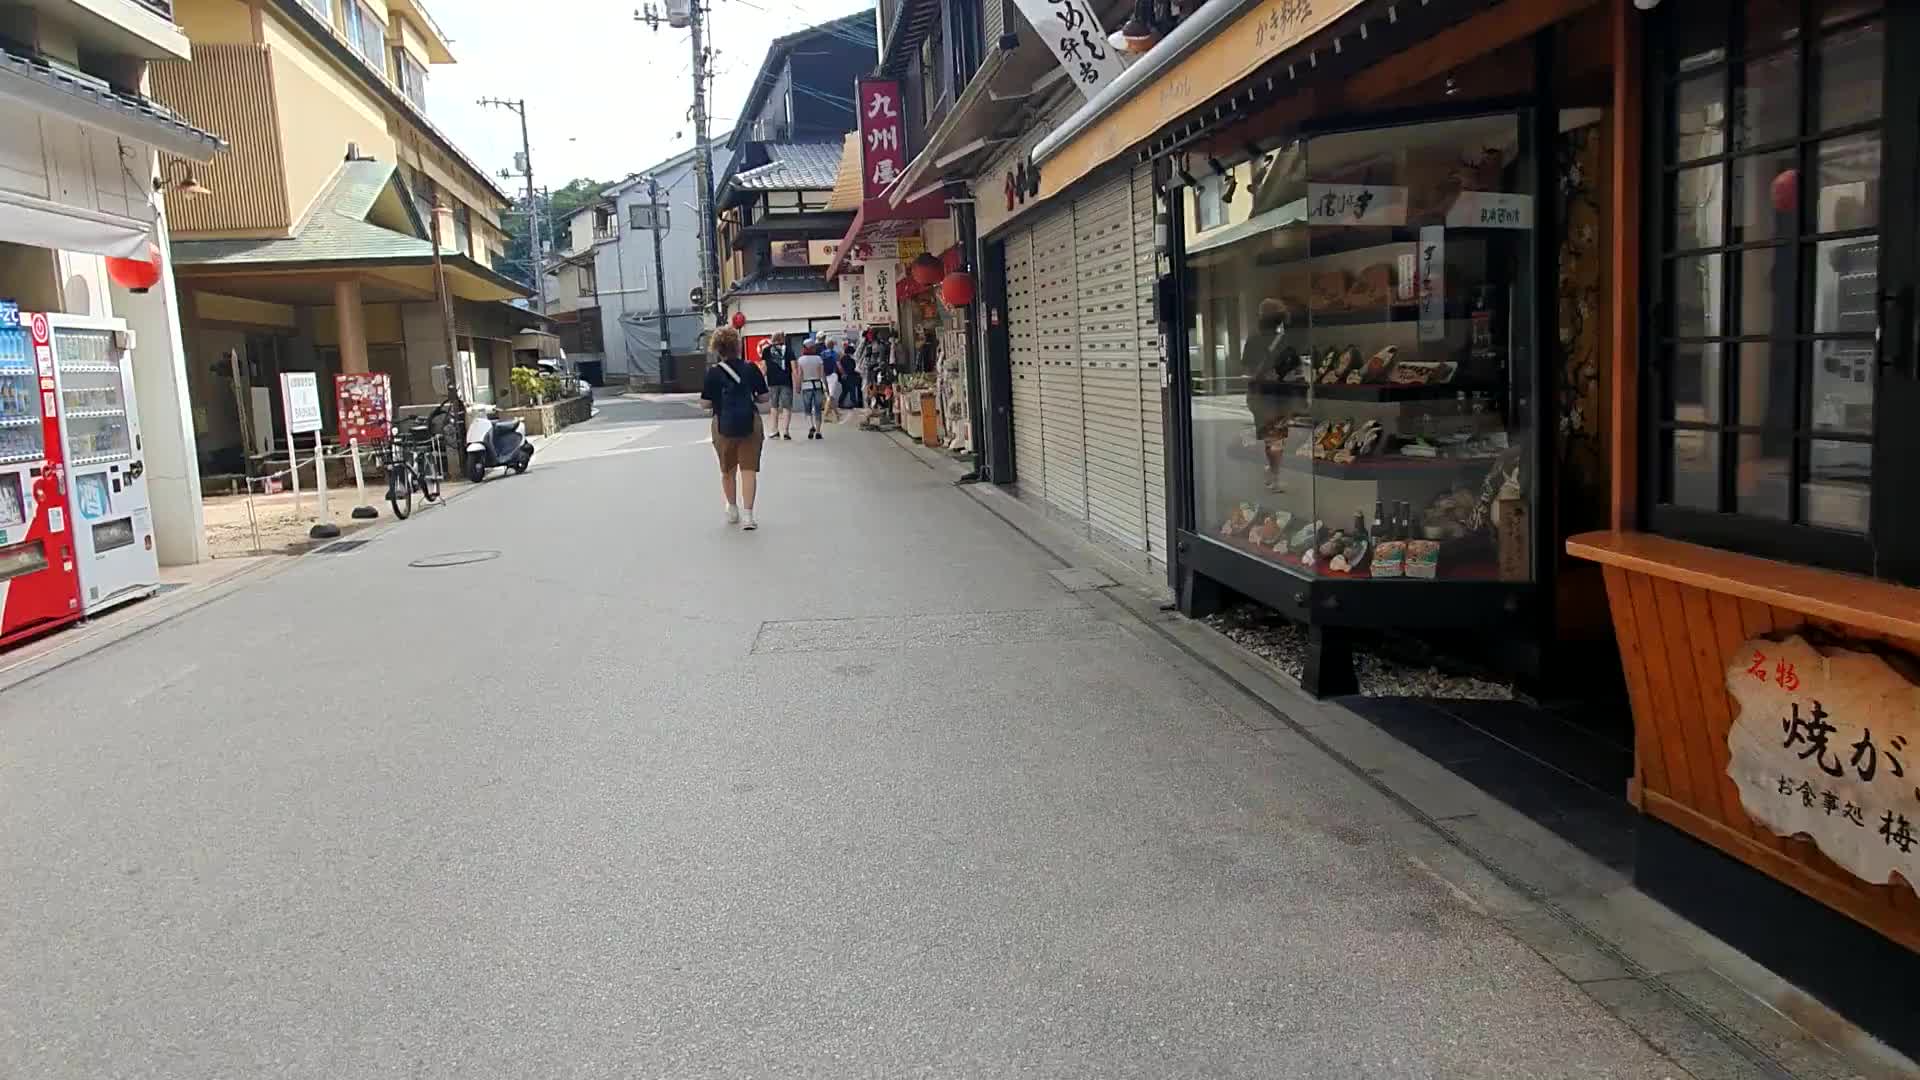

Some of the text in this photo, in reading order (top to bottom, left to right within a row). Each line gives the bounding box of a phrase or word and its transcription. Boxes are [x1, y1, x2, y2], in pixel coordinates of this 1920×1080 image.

[867, 92, 901, 185] 九州屋
[1747, 650, 1800, 691] 名物
[1783, 701, 1920, 802] 焼が
[1778, 775, 1919, 854] お食事処 梅
